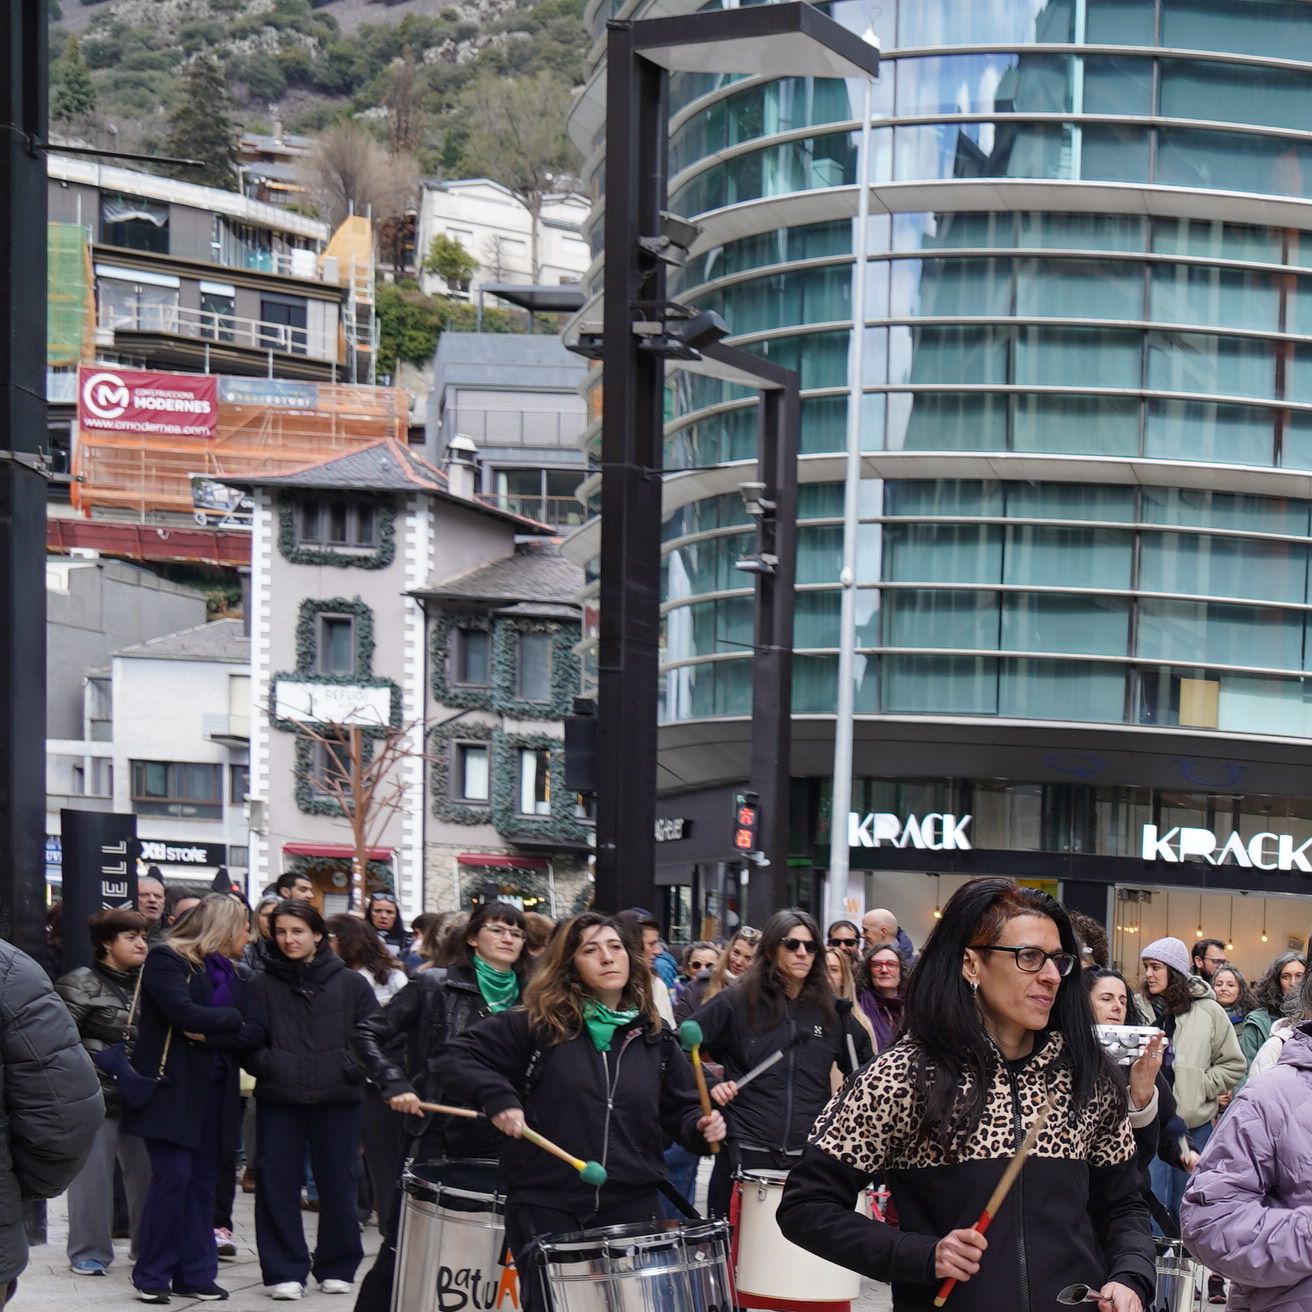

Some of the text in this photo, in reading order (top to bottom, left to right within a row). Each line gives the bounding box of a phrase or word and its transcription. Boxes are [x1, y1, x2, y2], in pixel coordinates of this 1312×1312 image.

[134, 396, 211, 414] MODERNES
[847, 811, 974, 851] KRACK
[166, 848, 208, 863] STORE
